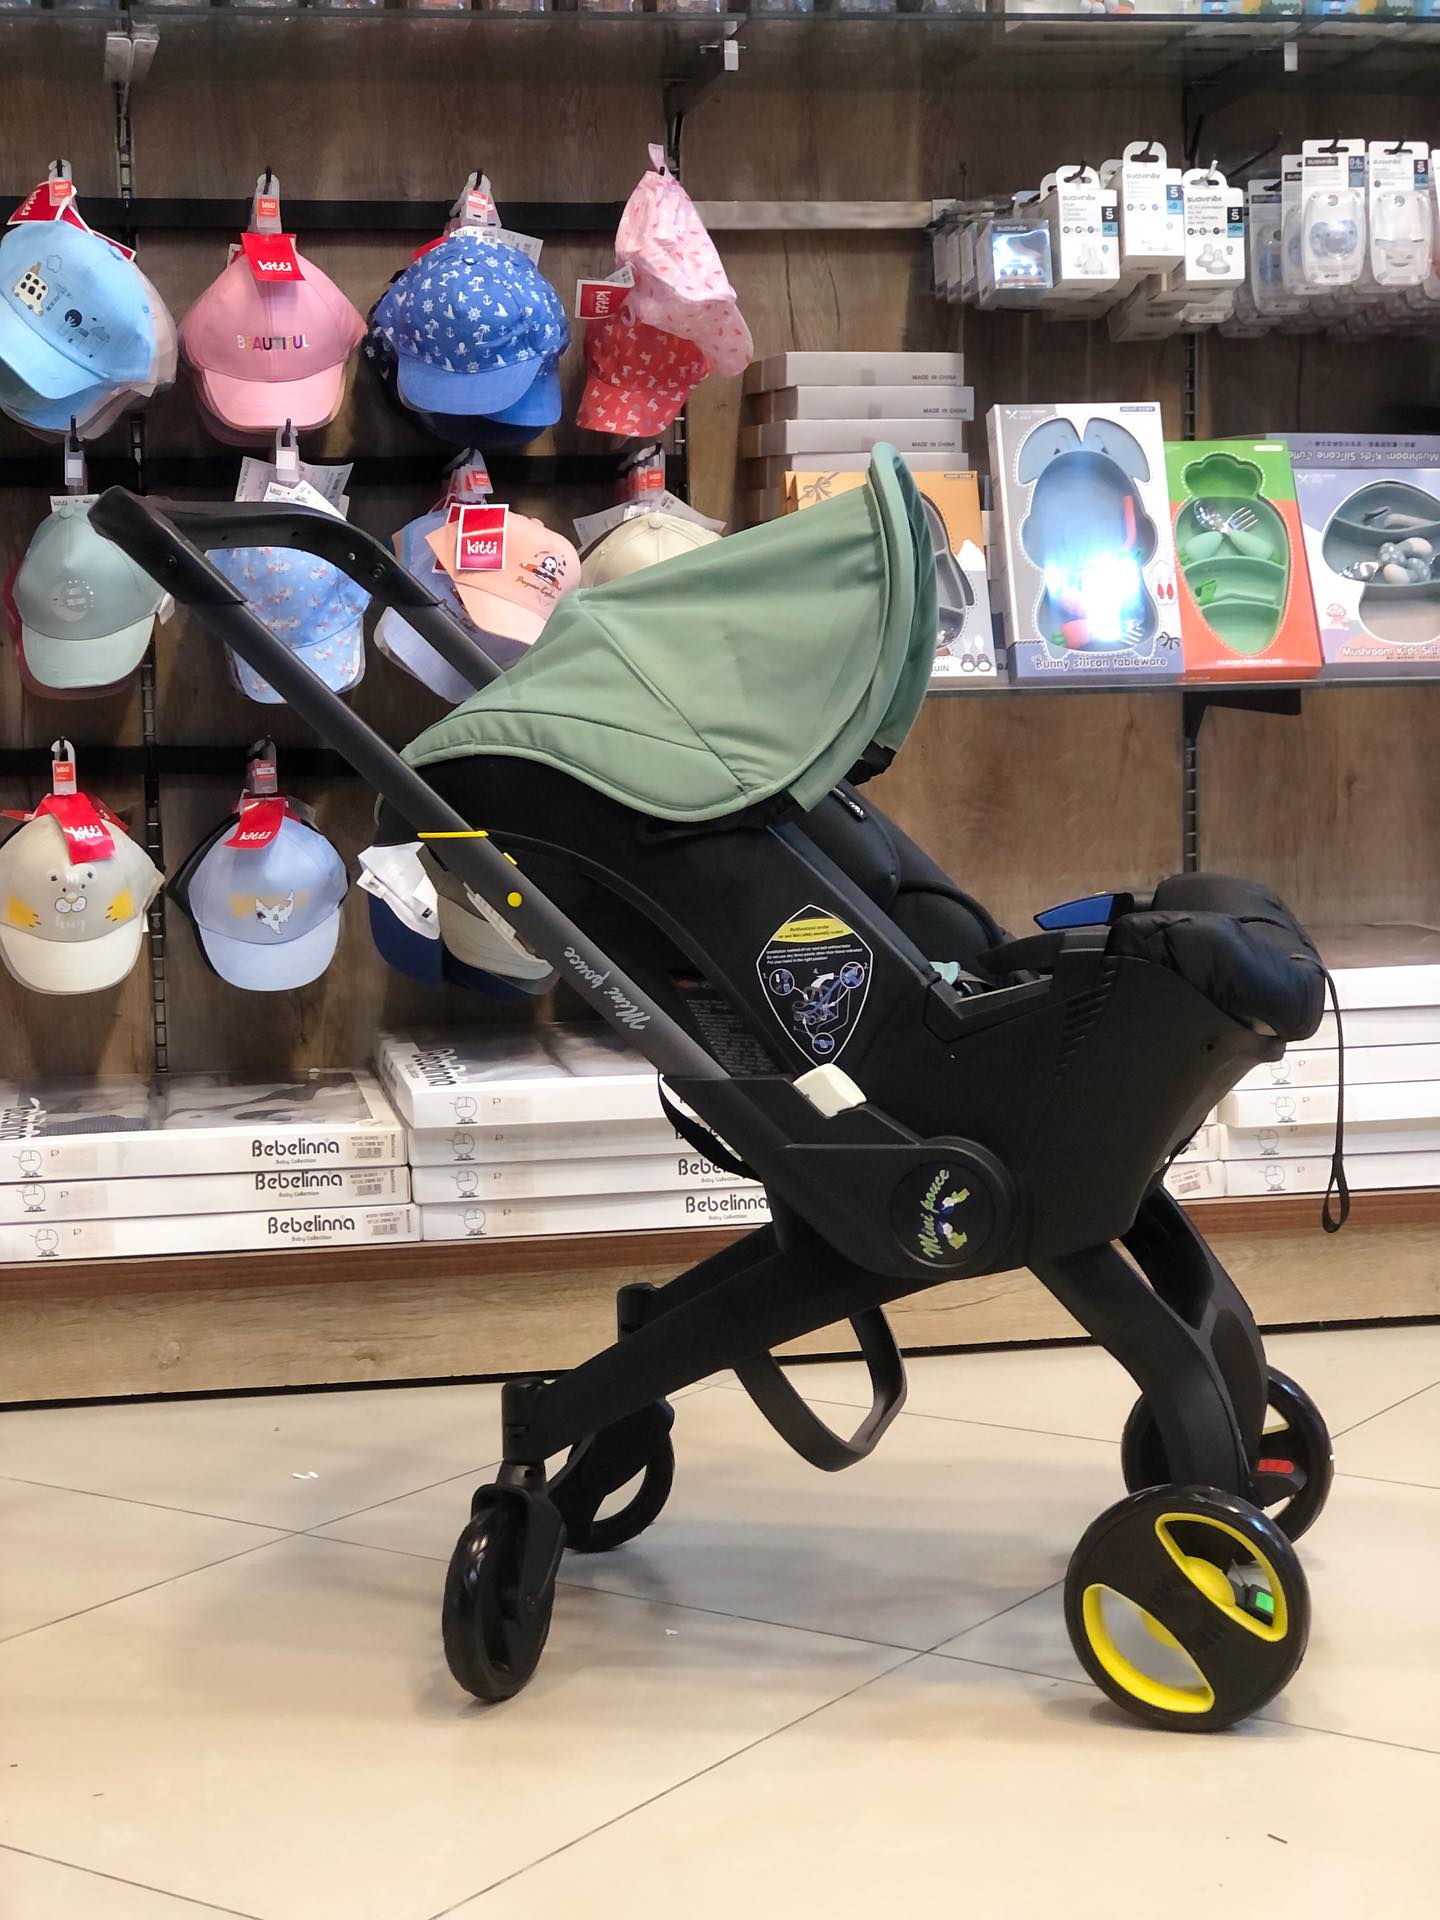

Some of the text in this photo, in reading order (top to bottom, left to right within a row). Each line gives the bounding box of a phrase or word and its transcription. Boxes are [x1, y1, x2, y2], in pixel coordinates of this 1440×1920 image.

[257, 260, 293, 272] kitti
[594, 290, 612, 314] kitti
[236, 334, 309, 350] BEAUTIFUL
[466, 539, 498, 555] kitti
[1342, 647, 1393, 656] Mushroom
[1396, 645, 1416, 655] Kids
[1036, 656, 1167, 670] Bunny silicon tableware
[63, 825, 104, 842] kitti
[239, 831, 271, 842] kitti
[563, 946, 651, 1030] Mini pouce
[252, 1138, 340, 1157] Bebelinna
[255, 1171, 343, 1190] Bebelinna
[685, 1194, 770, 1213] Bebelinna
[918, 1169, 950, 1258] Mini pouce
[267, 1215, 356, 1234] Bebelinna
